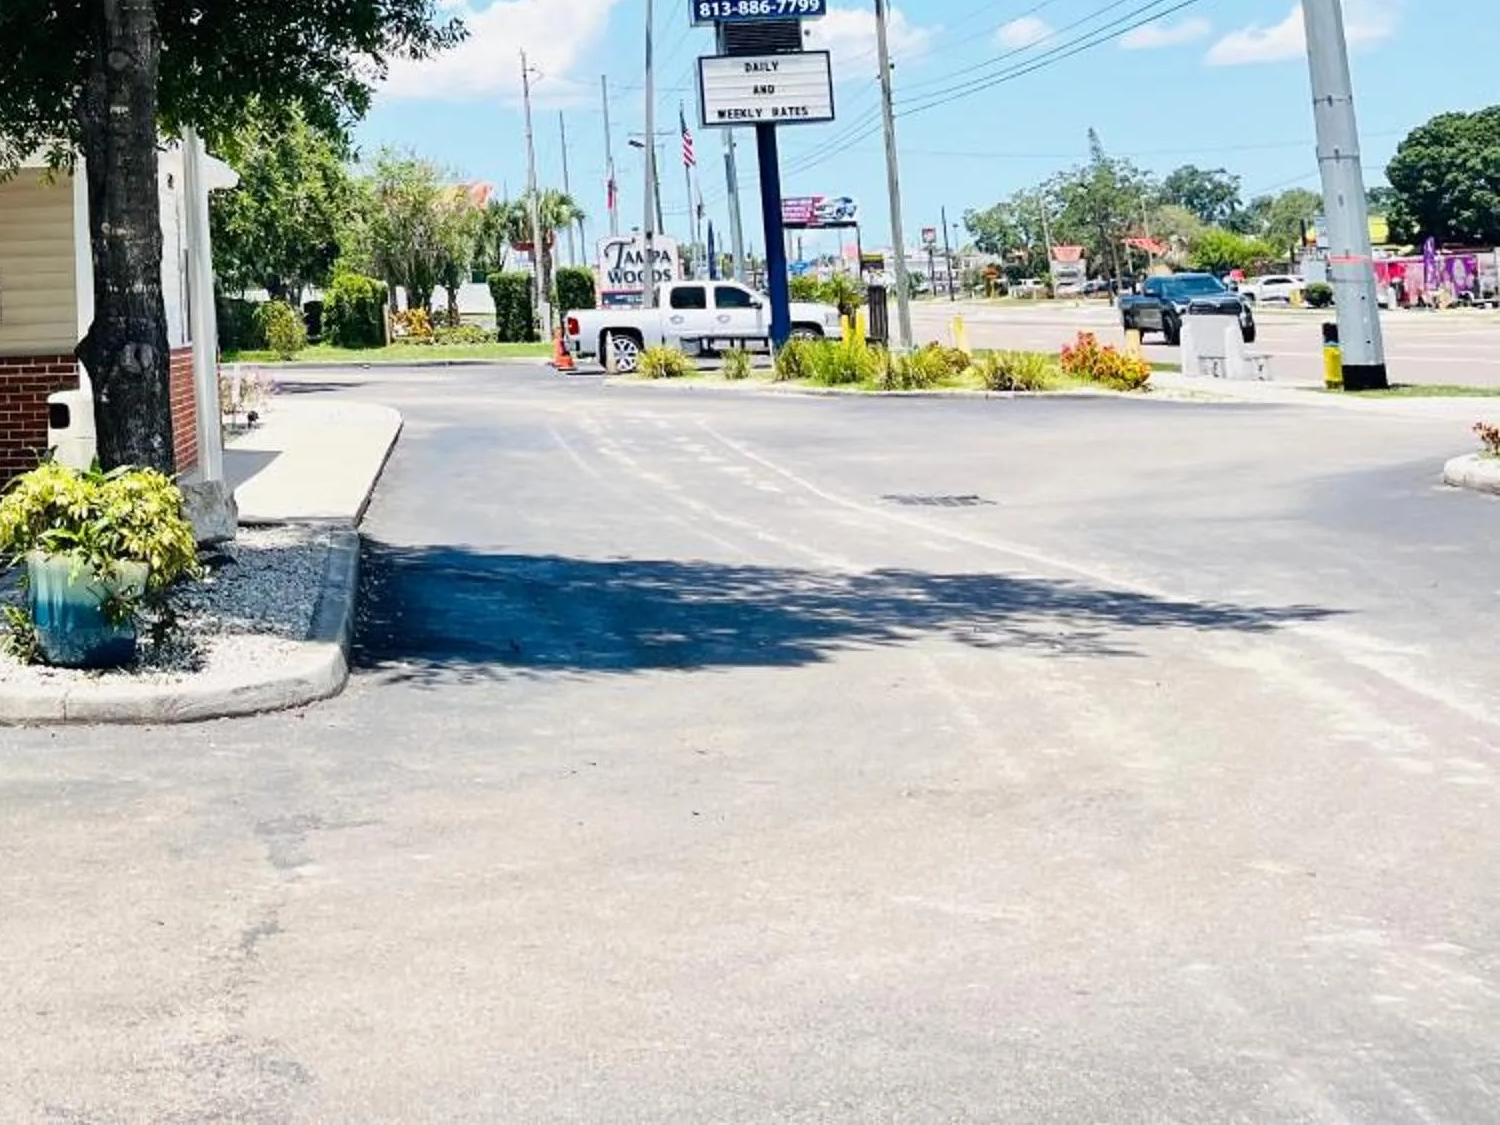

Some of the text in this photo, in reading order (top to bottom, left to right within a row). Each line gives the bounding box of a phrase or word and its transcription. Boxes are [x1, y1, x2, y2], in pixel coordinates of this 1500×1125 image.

[744, 62, 779, 73] DAILY
[753, 85, 775, 94] AND
[717, 106, 808, 119] WEEKLY RATES
